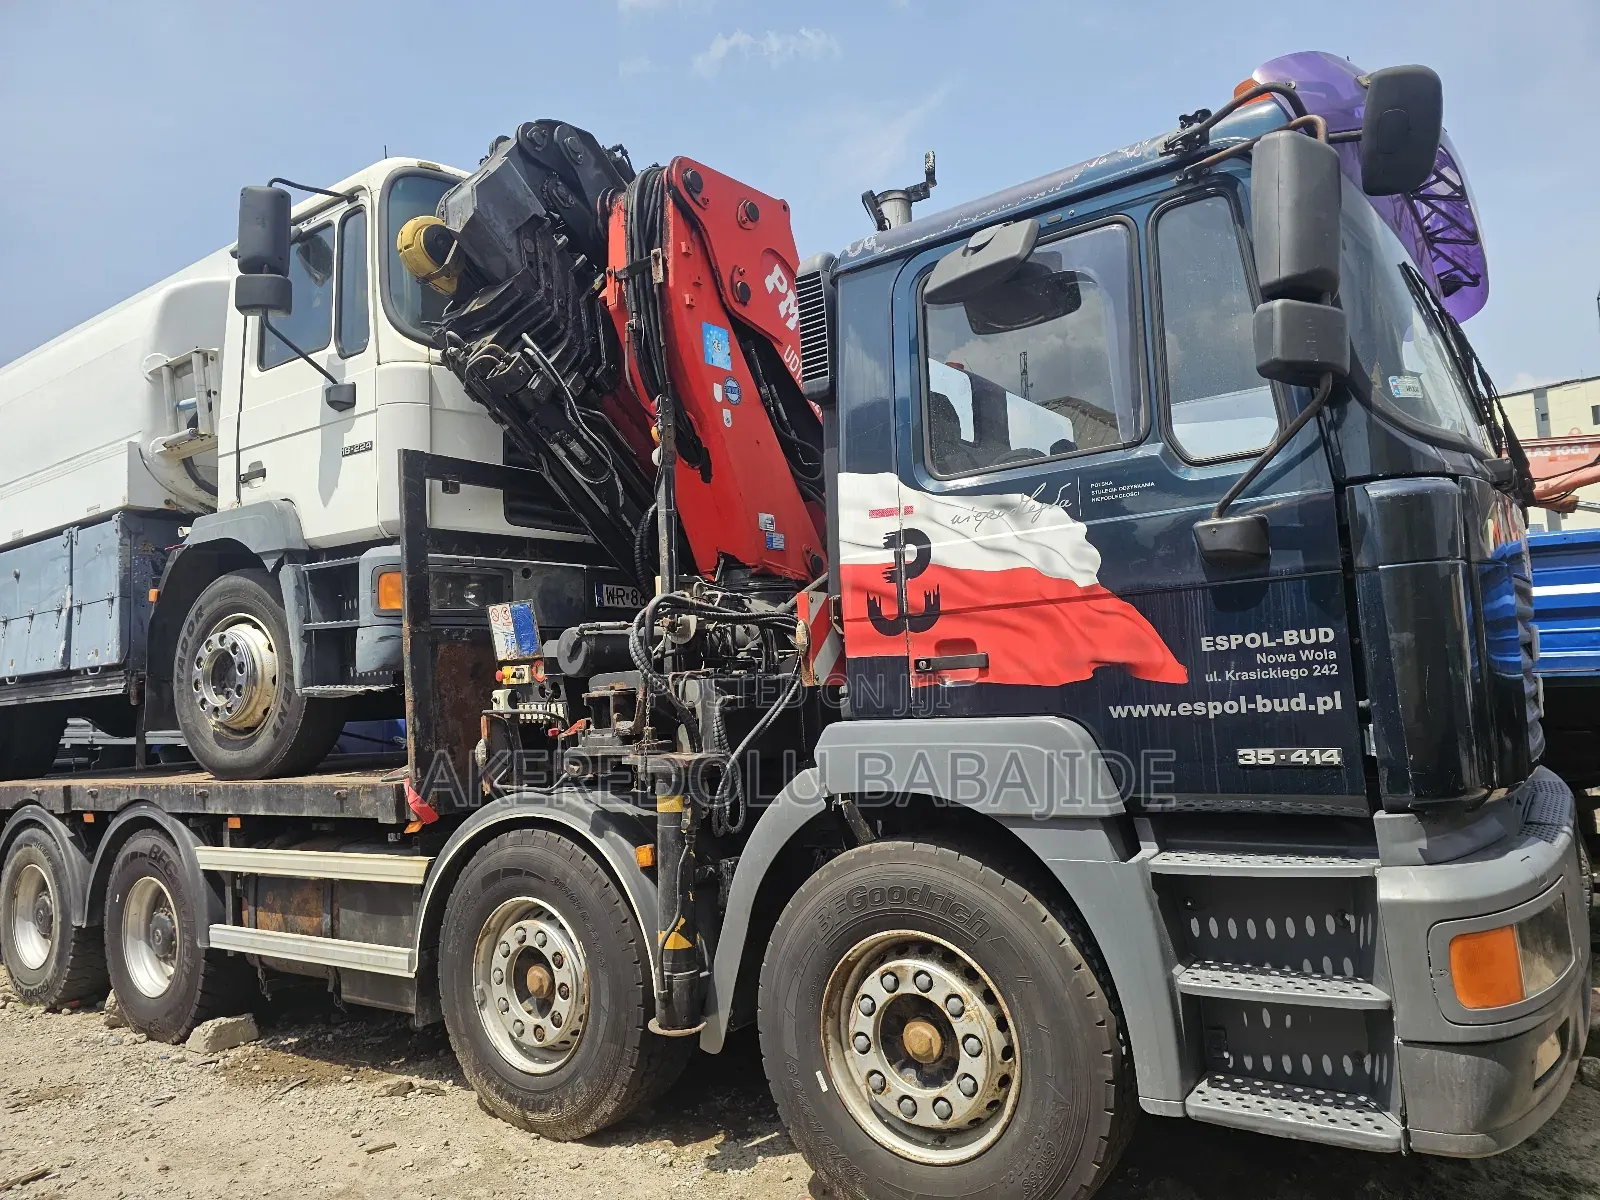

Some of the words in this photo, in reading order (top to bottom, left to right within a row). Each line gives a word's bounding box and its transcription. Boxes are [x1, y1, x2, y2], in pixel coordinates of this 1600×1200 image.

[765, 264, 800, 330] PM
[605, 586, 626, 606] WR
[1201, 628, 1335, 652] ESPOL-BUD
[1256, 652, 1297, 665] Nowa
[1299, 649, 1337, 662] Wola
[1205, 671, 1222, 683] ul.
[1225, 665, 1309, 682] Krasickiego
[1312, 664, 1339, 676] 242
[1108, 691, 1343, 719] www.espol-bud.pl
[811, 884, 992, 939] BFGoodrich
